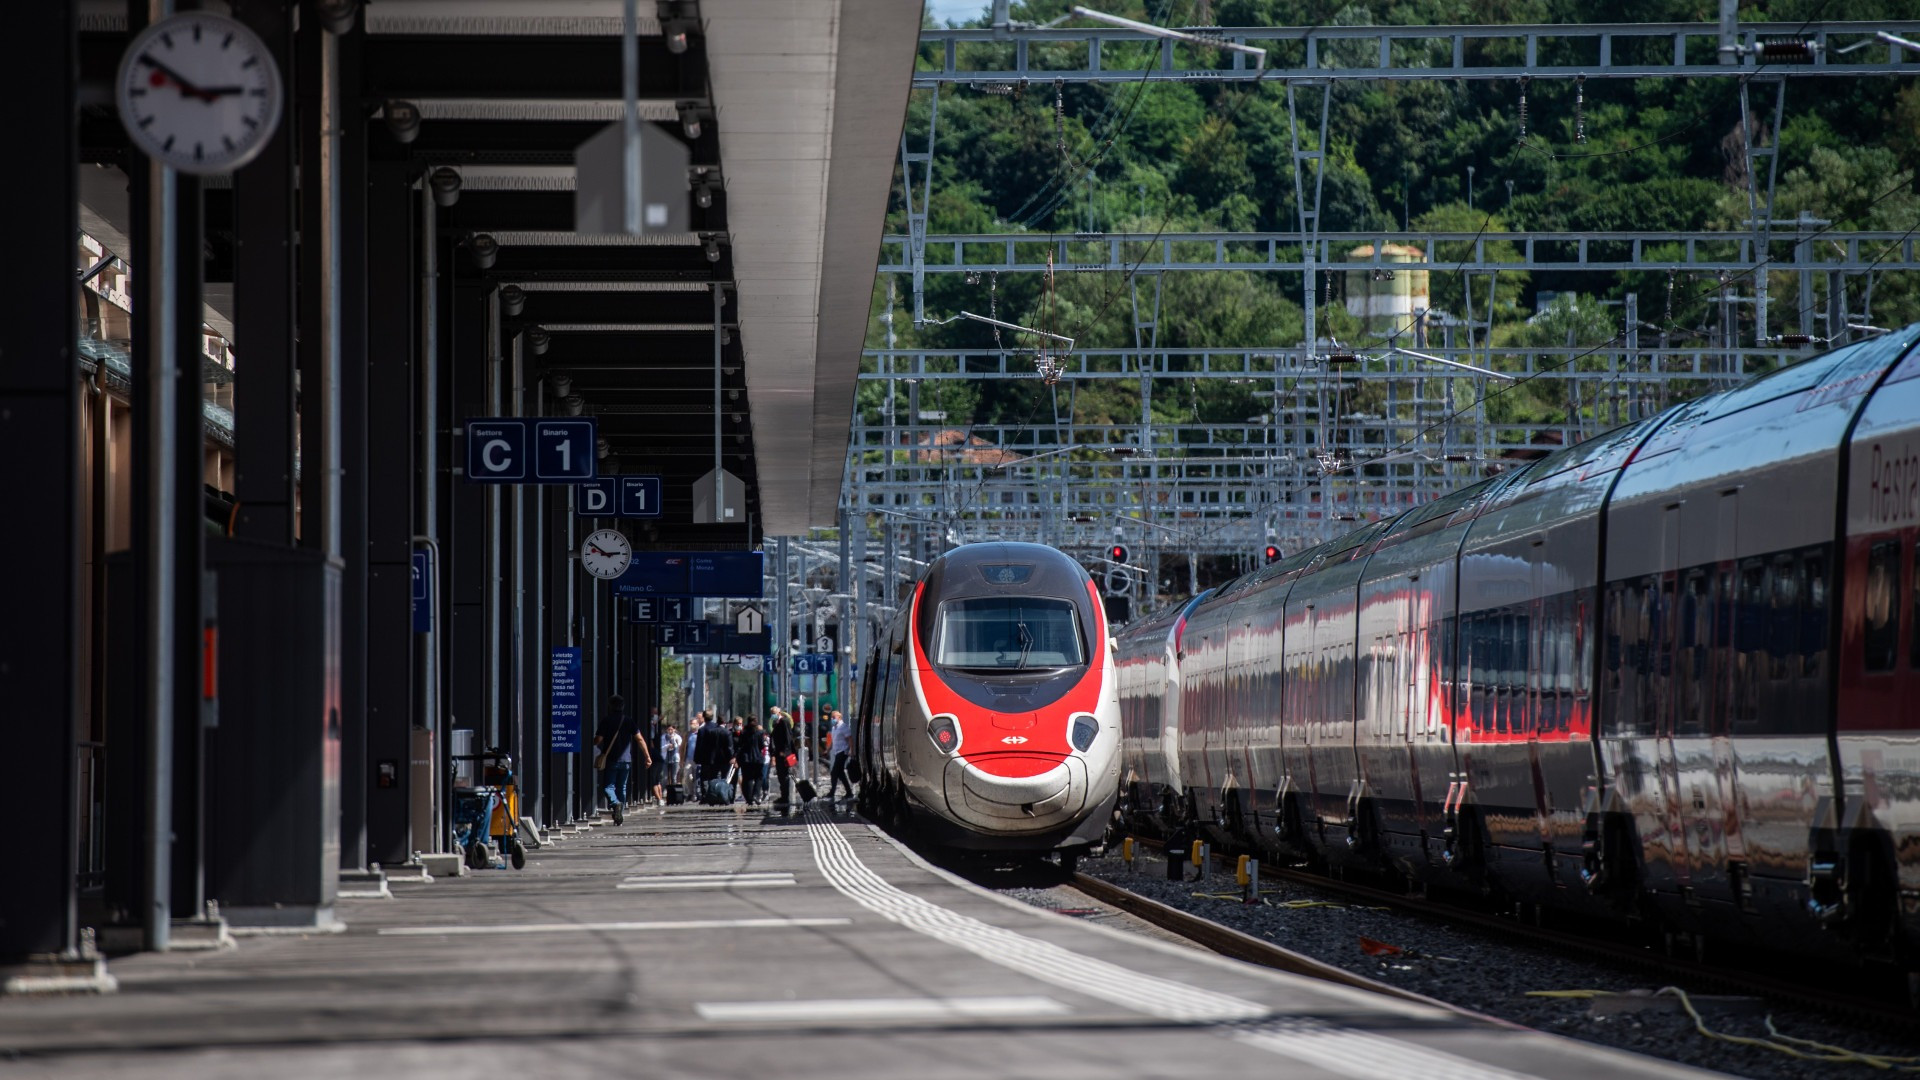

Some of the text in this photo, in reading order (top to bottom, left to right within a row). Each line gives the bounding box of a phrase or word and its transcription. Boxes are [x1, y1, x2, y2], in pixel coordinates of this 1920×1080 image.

[482, 439, 512, 472] C
[555, 439, 571, 471] 1
[587, 489, 607, 510] D
[634, 489, 645, 510] 1
[638, 603, 651, 619] E
[673, 603, 681, 619] 1
[747, 612, 753, 632] 1
[664, 628, 674, 642] F
[692, 628, 699, 642] 1
[821, 639, 828, 651] 3
